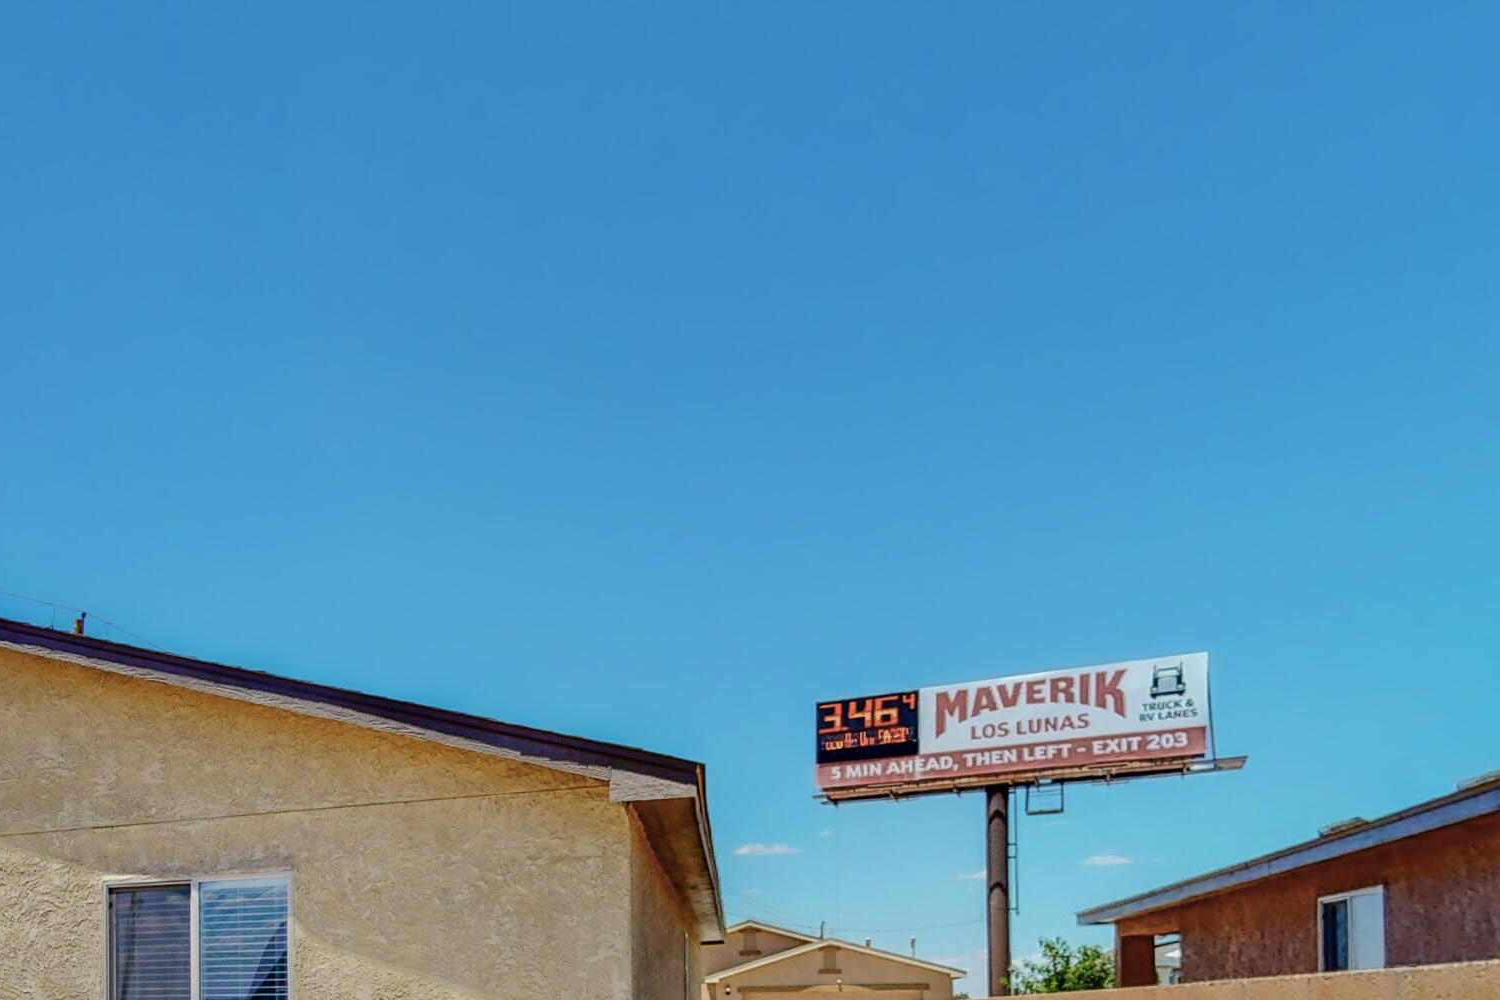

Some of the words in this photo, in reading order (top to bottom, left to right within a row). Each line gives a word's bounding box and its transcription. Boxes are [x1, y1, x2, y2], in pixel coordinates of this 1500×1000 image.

[935, 669, 1127, 739] MAVERIK
[1139, 713, 1156, 721] RV
[1157, 708, 1198, 720] LANES
[1142, 699, 1183, 711] TRUCK
[1185, 698, 1194, 707] &
[970, 722, 1010, 740] LOS
[1016, 713, 1090, 735] LUNAS
[830, 766, 841, 779] 5
[846, 763, 882, 778] MIN
[885, 756, 959, 774] AHEAD,
[963, 748, 1018, 768] THEN
[1022, 743, 1072, 761] LEFT
[1092, 737, 1141, 756] EXIT
[1146, 732, 1188, 750] 203
